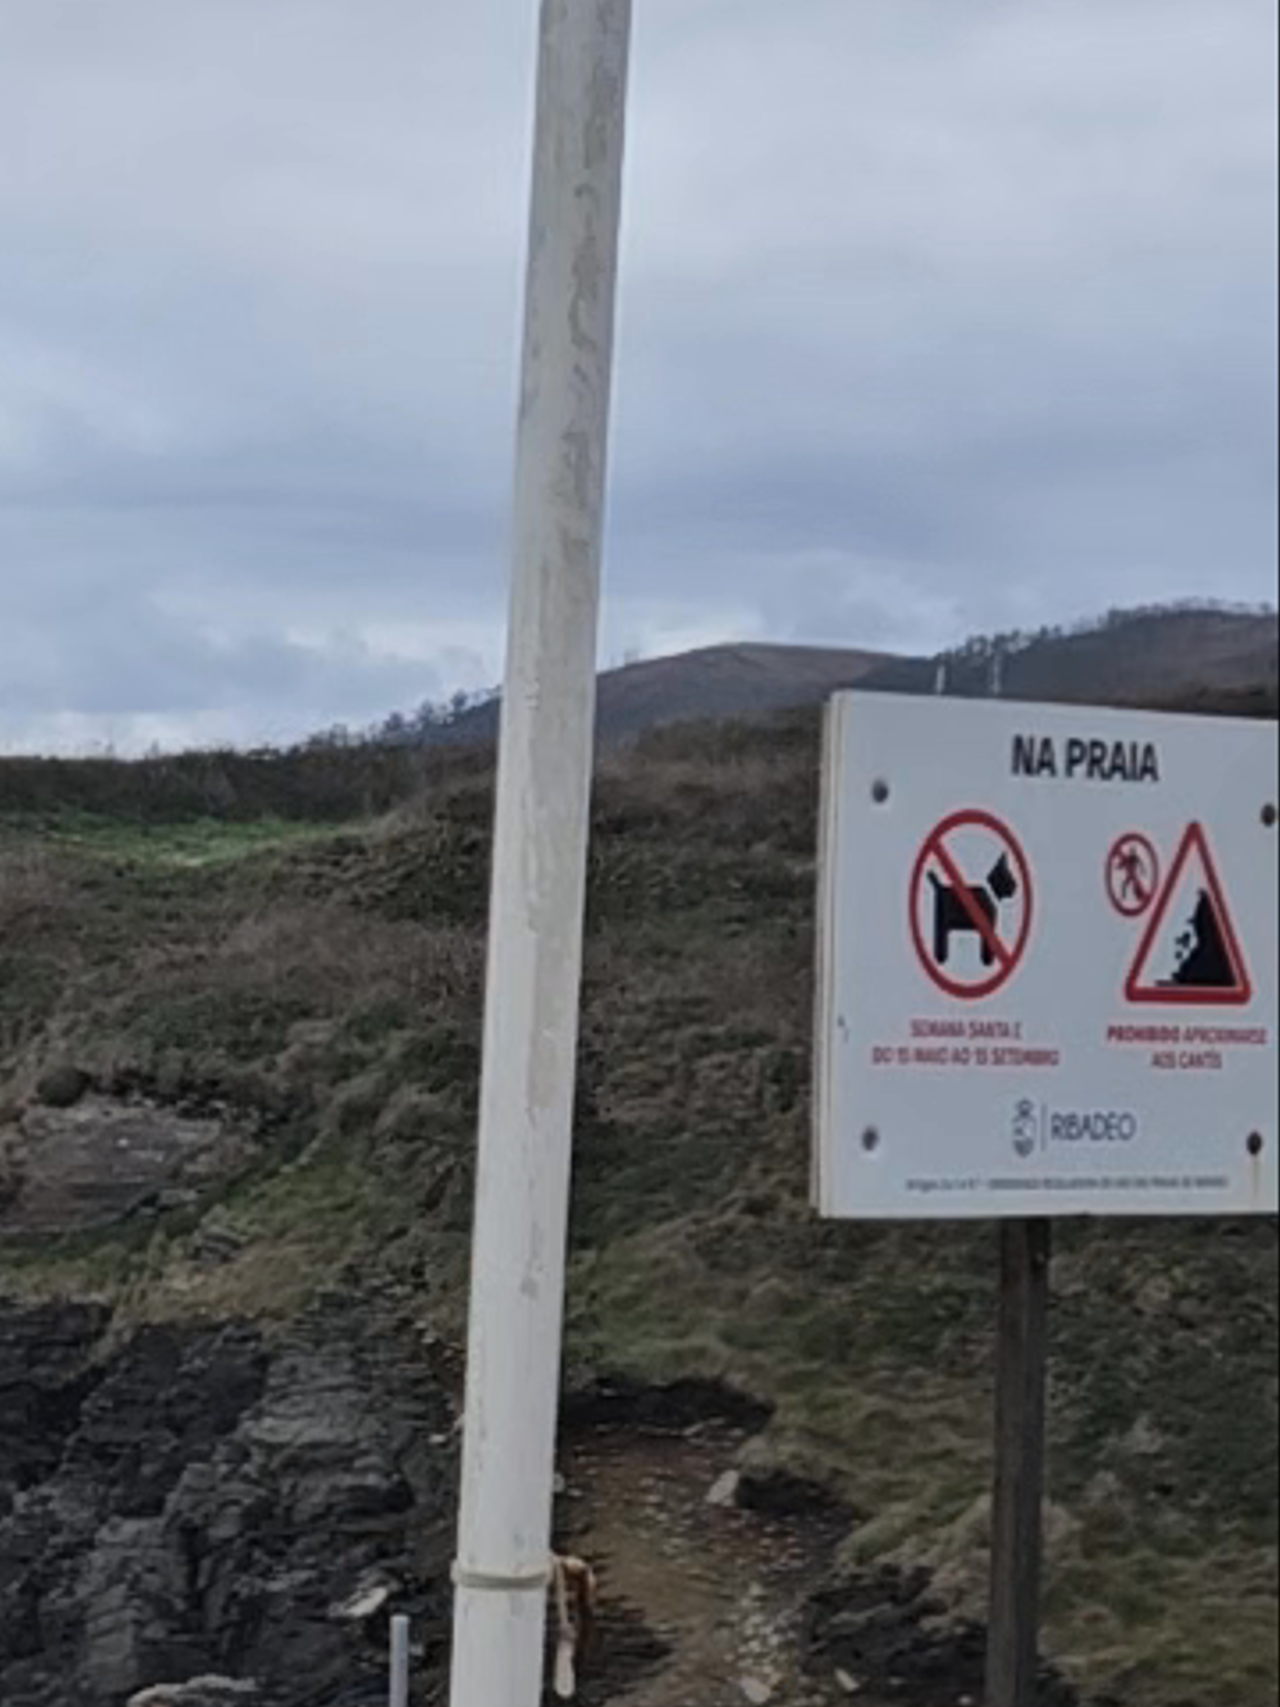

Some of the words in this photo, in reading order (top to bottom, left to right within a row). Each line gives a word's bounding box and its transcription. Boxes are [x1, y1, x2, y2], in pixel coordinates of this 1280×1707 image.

[1011, 734, 1056, 777] NA
[1065, 737, 1159, 781] PRAIA
[968, 1020, 1010, 1040] SANTA
[1107, 1025, 1181, 1042] PROHIBIDO
[872, 1047, 893, 1065] DO
[951, 1048, 971, 1066] AO
[1050, 1111, 1138, 1142] RIBADEO
